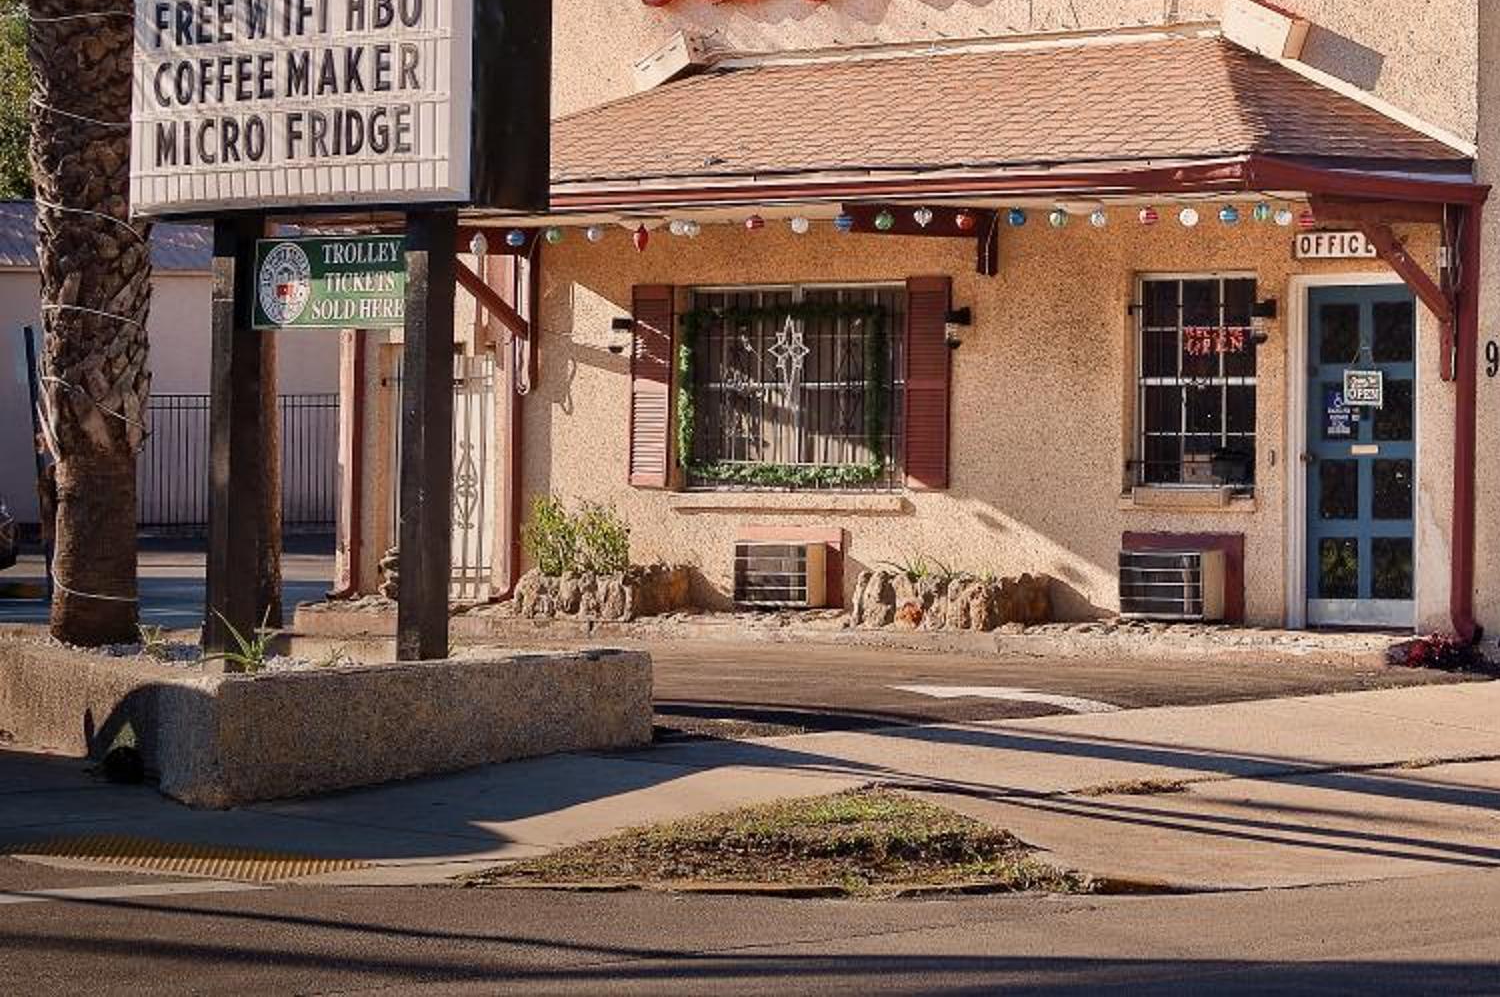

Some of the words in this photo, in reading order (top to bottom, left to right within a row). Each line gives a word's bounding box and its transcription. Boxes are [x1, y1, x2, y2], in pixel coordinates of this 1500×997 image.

[153, 56, 275, 108] COFFEE
[285, 42, 421, 98] MAKER
[155, 114, 266, 167] MICRO
[286, 105, 412, 159] FRIDGE
[322, 242, 400, 265] TROLLEY
[324, 271, 396, 293] TICKETS
[311, 299, 355, 320] SOLD
[358, 297, 404, 318] HERE
[1347, 388, 1379, 400] OPEN
